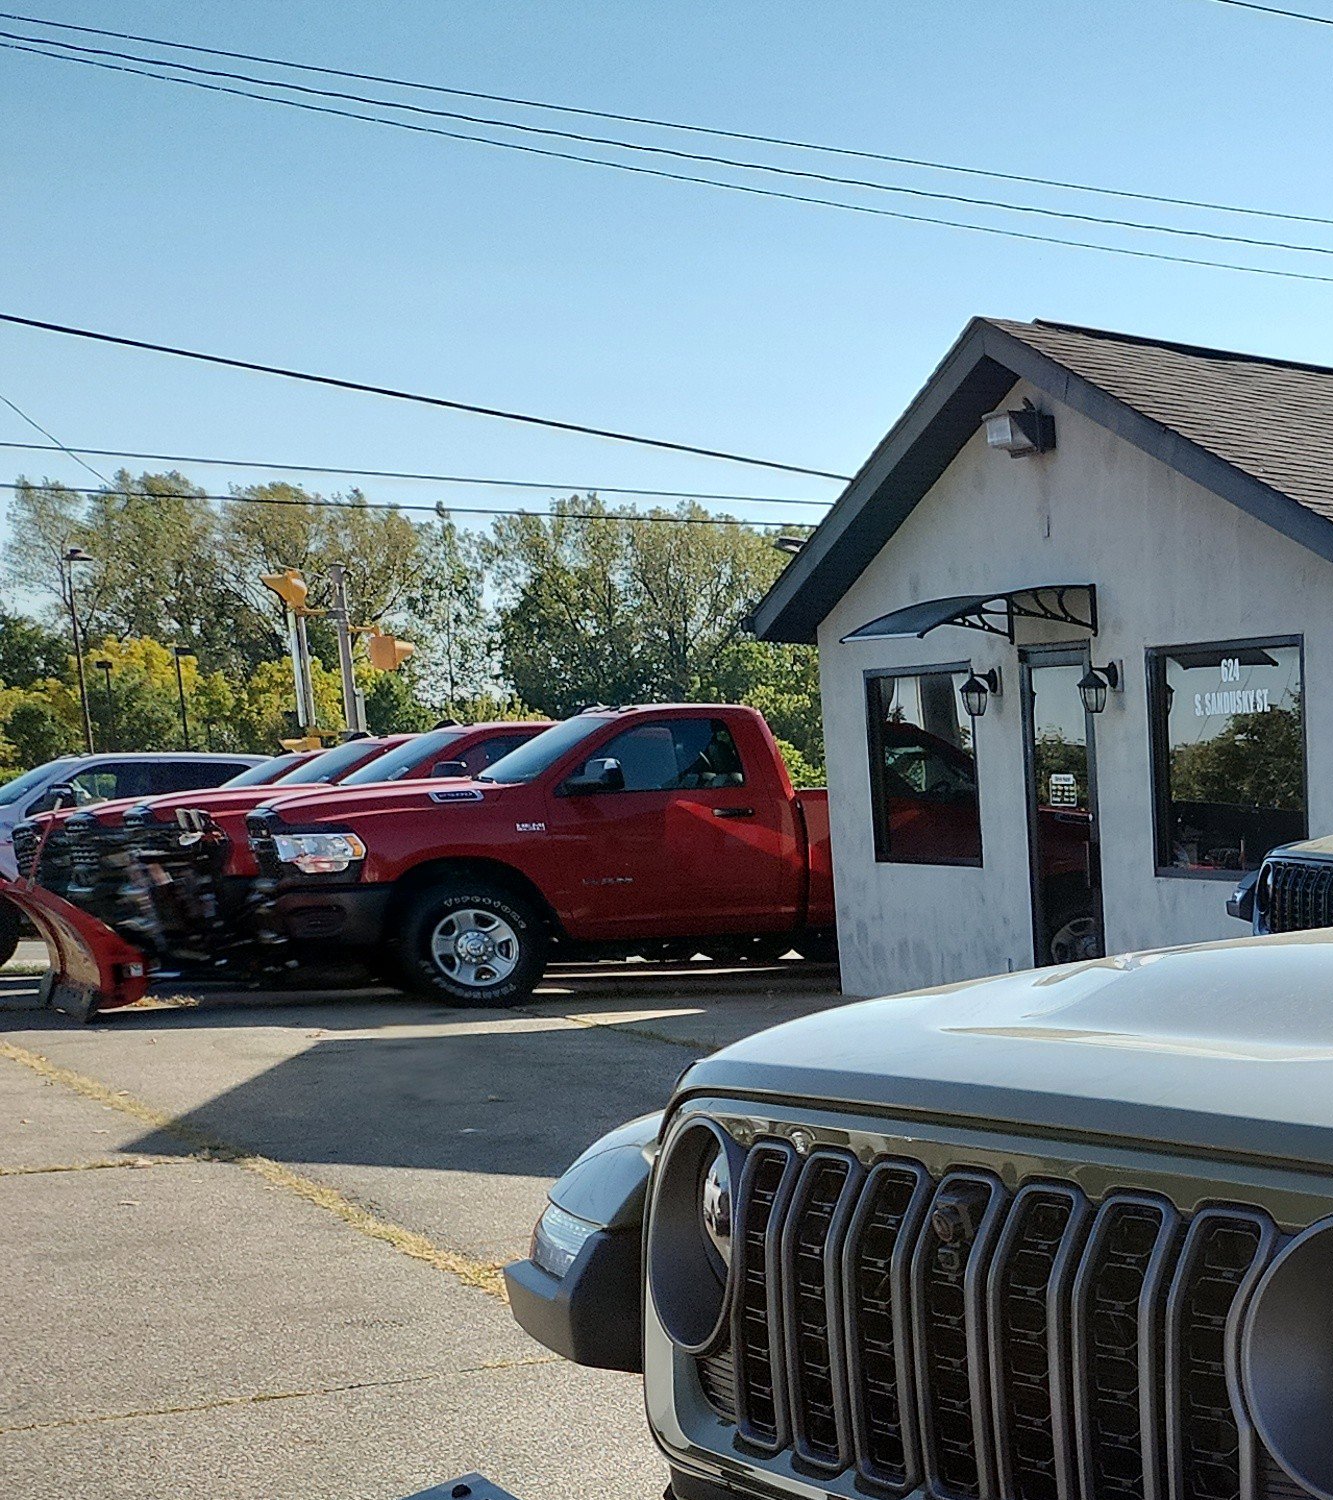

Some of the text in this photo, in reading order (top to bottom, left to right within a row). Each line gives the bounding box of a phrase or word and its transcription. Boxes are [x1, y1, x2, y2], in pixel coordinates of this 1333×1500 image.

[1221, 658, 1240, 682] 624
[1194, 688, 1271, 717] S. SANDUSKY ST.
